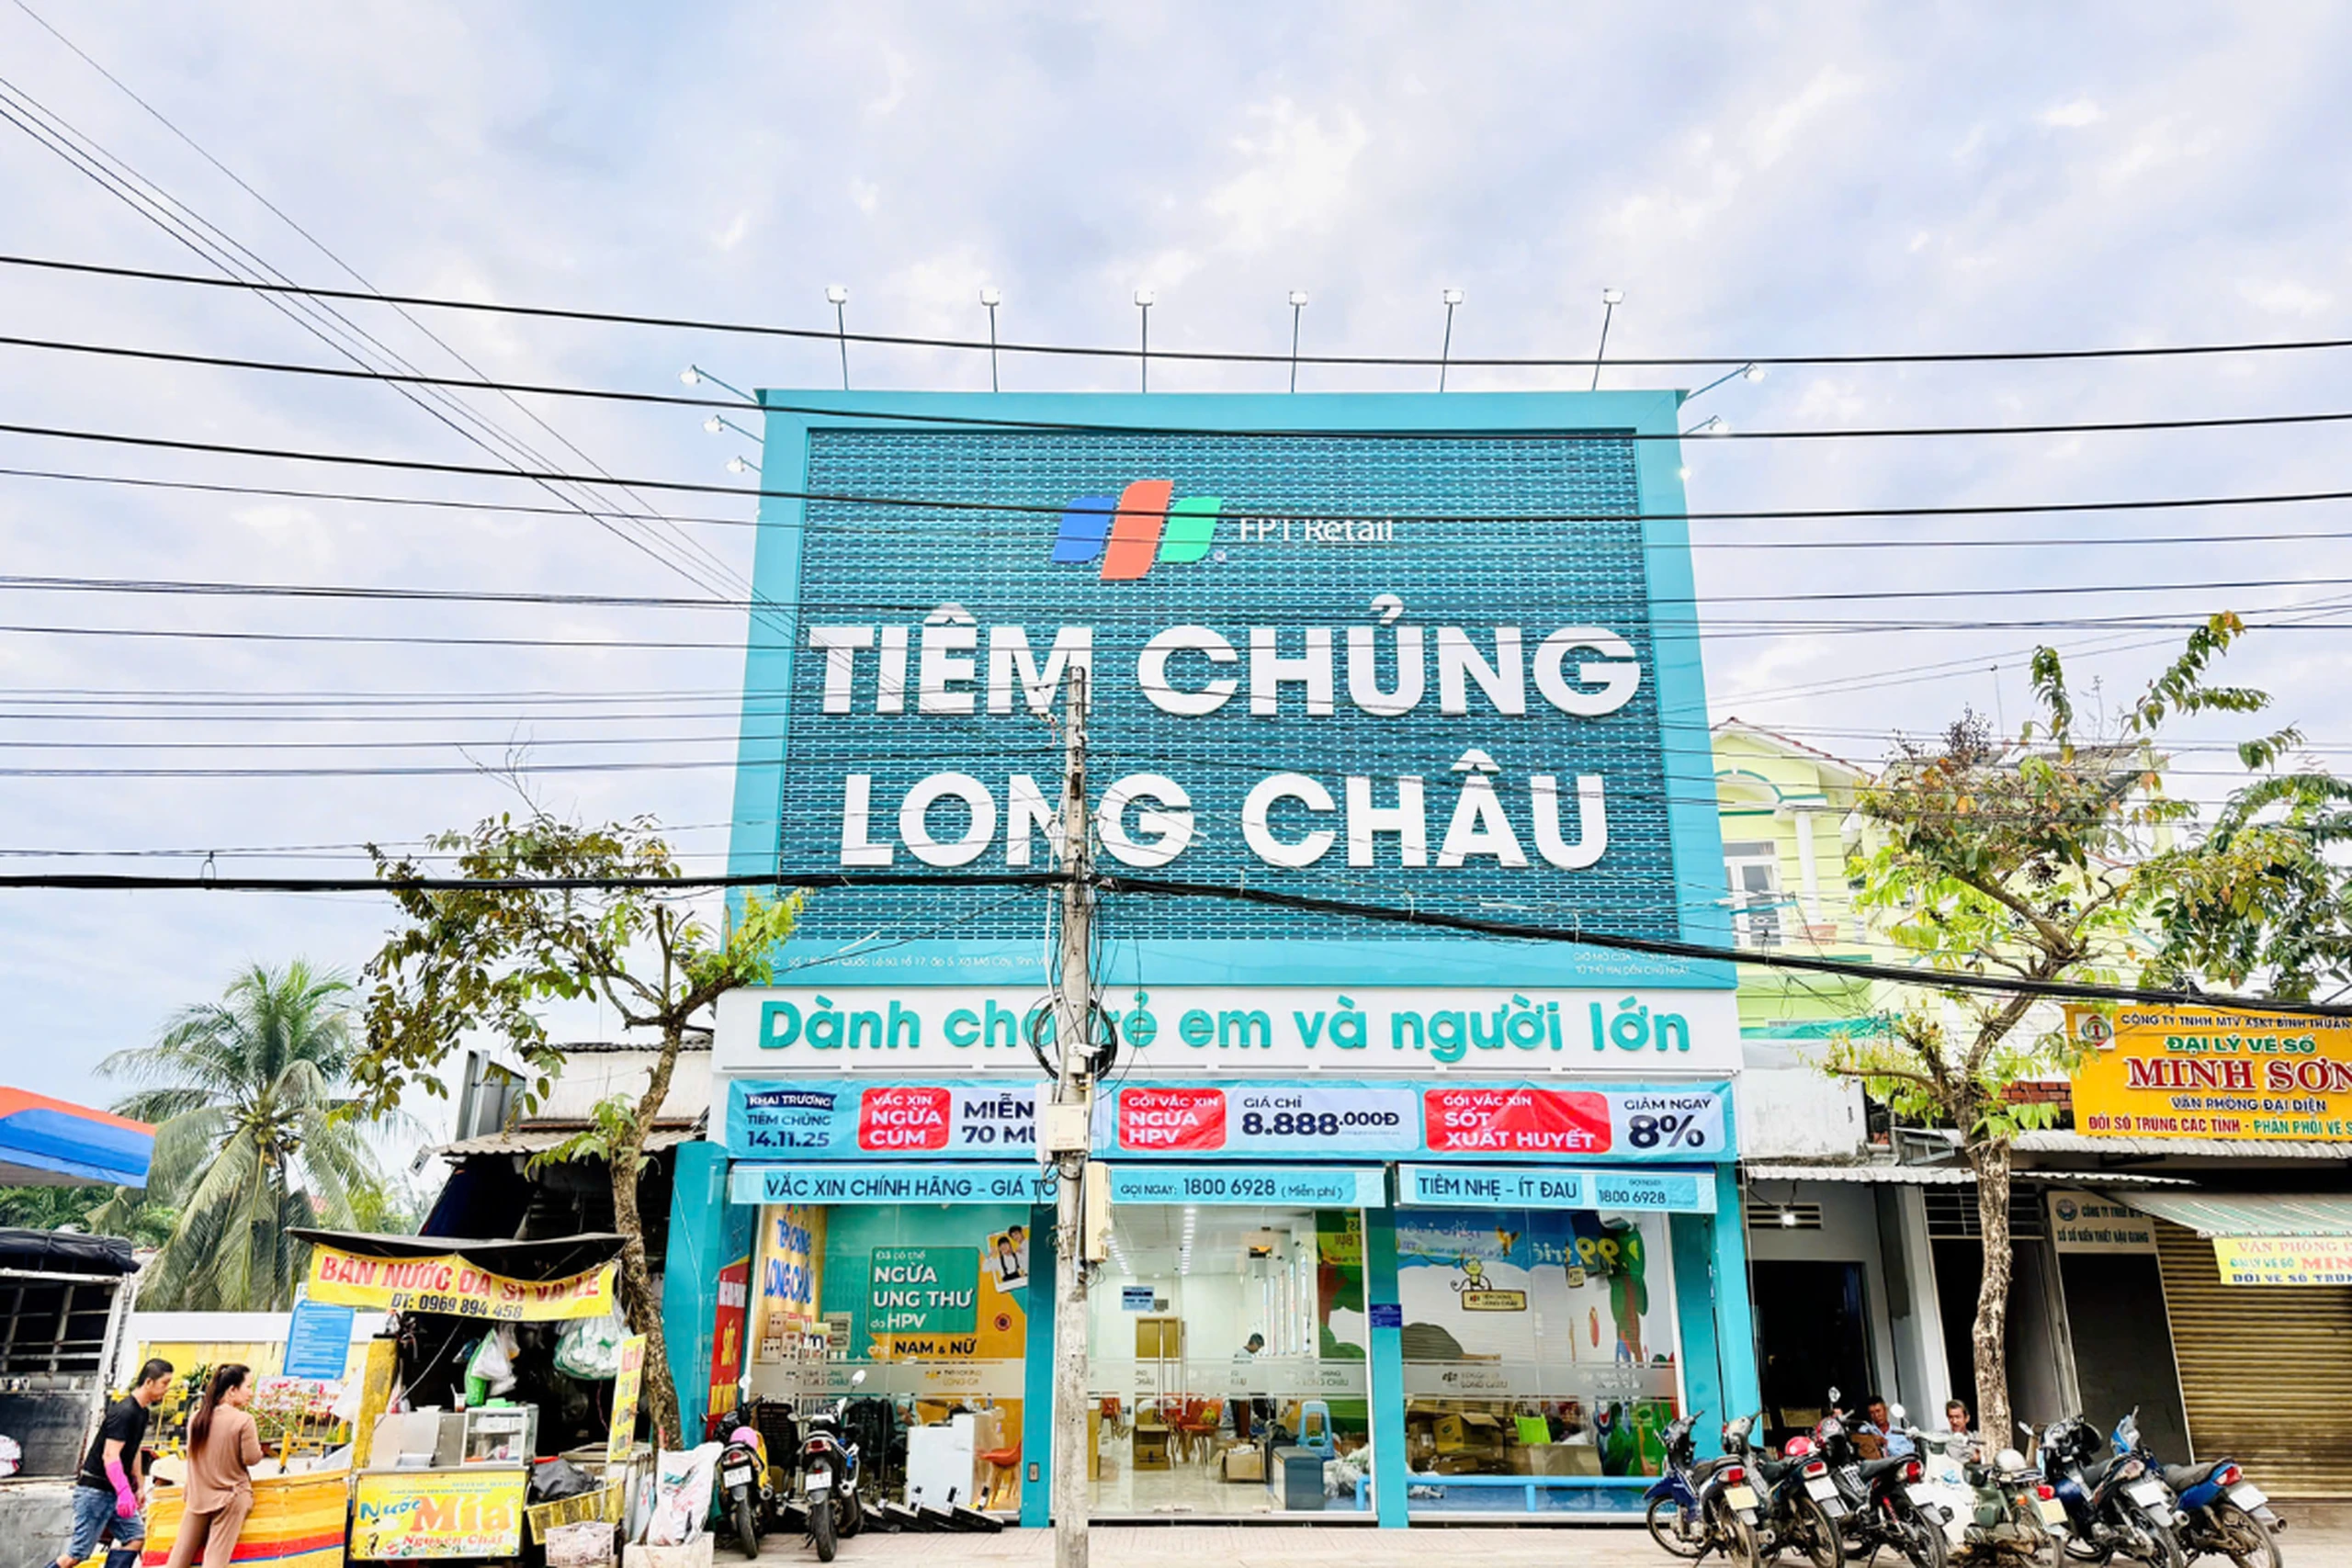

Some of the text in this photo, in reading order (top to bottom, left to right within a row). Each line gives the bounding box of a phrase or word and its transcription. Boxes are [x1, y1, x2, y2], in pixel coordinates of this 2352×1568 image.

[1240, 514, 1393, 542] FPT Retail
[808, 594, 1642, 716] TIÊM CHỦNG
[841, 749, 1609, 869] LONG CHÂU
[758, 995, 921, 1049] Dành
[1088, 991, 1158, 1048] rẻ
[1179, 1009, 1272, 1049] em
[1294, 995, 1367, 1049] và
[1392, 993, 1563, 1063] người
[1589, 996, 1690, 1051] lớn
[2121, 1012, 2159, 1026] CÔNG
[2163, 1015, 2176, 1025] TY
[2179, 1016, 2212, 1026] TNHH
[2217, 1017, 2240, 1027] MTV
[2278, 1014, 2306, 1028] BÌNH
[2166, 1033, 2316, 1055] ĐẠI LÝ VÉ SỐ
[2126, 1057, 2352, 1091] MINH SƠN
[750, 1094, 831, 1107] KHAI TRƯƠNG
[908, 1095, 933, 1106] XIN
[964, 1092, 1035, 1119] MIỄN
[1128, 1096, 1156, 1107] GÓI
[1194, 1097, 1218, 1107] XIN
[1243, 1095, 1303, 1108] GIÁ CHỈ
[1443, 1094, 1469, 1106] GÓI
[1507, 1096, 1532, 1106] XIN
[1624, 1099, 1711, 1111] GIẢM NGAY
[2171, 1095, 2327, 1114] VĂN PHÒNG ĐẠI DIỆN
[747, 1111, 831, 1126] TIÊM CHỦNG
[871, 1108, 943, 1125] NGỪA
[1128, 1109, 1199, 1125] NGỪA
[1444, 1107, 1490, 1127] SỐT
[2114, 1113, 2131, 1130] SỐ
[2135, 1114, 2177, 1131] TRÚNG
[2181, 1114, 2206, 1132] CÁC
[2210, 1114, 2241, 1132] TỈNH
[2254, 1117, 2290, 1134] PHÂN
[2292, 1115, 2324, 1134] PHỐI
[747, 1131, 830, 1147] 14.11.25
[869, 1127, 926, 1145] CÚM
[962, 1125, 996, 1144] 70
[1128, 1130, 1181, 1144] HPV
[1445, 1128, 1596, 1149] XUẤT HUYẾT
[1628, 1114, 1706, 1149] 8%
[813, 1179, 845, 1196] XIN
[850, 1176, 910, 1196] CHÍNH
[915, 1176, 972, 1196] HÃNG
[991, 1175, 1025, 1196] GIÁ
[1121, 1184, 1143, 1198] GỌI
[1144, 1185, 1177, 1195] NGAY:
[1183, 1179, 1226, 1195] 1800
[1231, 1179, 1275, 1196] 6928
[1419, 1173, 1577, 1201] TIÊM NHẸ ÍT ĐAU
[1600, 1190, 1630, 1202] 1800
[1632, 1191, 1667, 1204] 6928
[876, 1250, 891, 1260] Đã
[894, 1250, 906, 1259] có
[2301, 1257, 2352, 1269] MIN
[320, 1255, 377, 1285] BÁN
[381, 1259, 453, 1292] NƯỚC
[874, 1261, 938, 1283] NGỪA
[419, 1294, 457, 1312] 0969
[460, 1298, 489, 1315] 894
[492, 1304, 523, 1319] 458
[874, 1288, 974, 1307] UNG THƯ
[870, 1313, 927, 1329] do HPV
[894, 1341, 934, 1355] NAM
[938, 1345, 945, 1355] &
[950, 1337, 978, 1355] NỮ
[360, 1495, 516, 1533] Nước Mía
[402, 1534, 462, 1548] Nguyên
